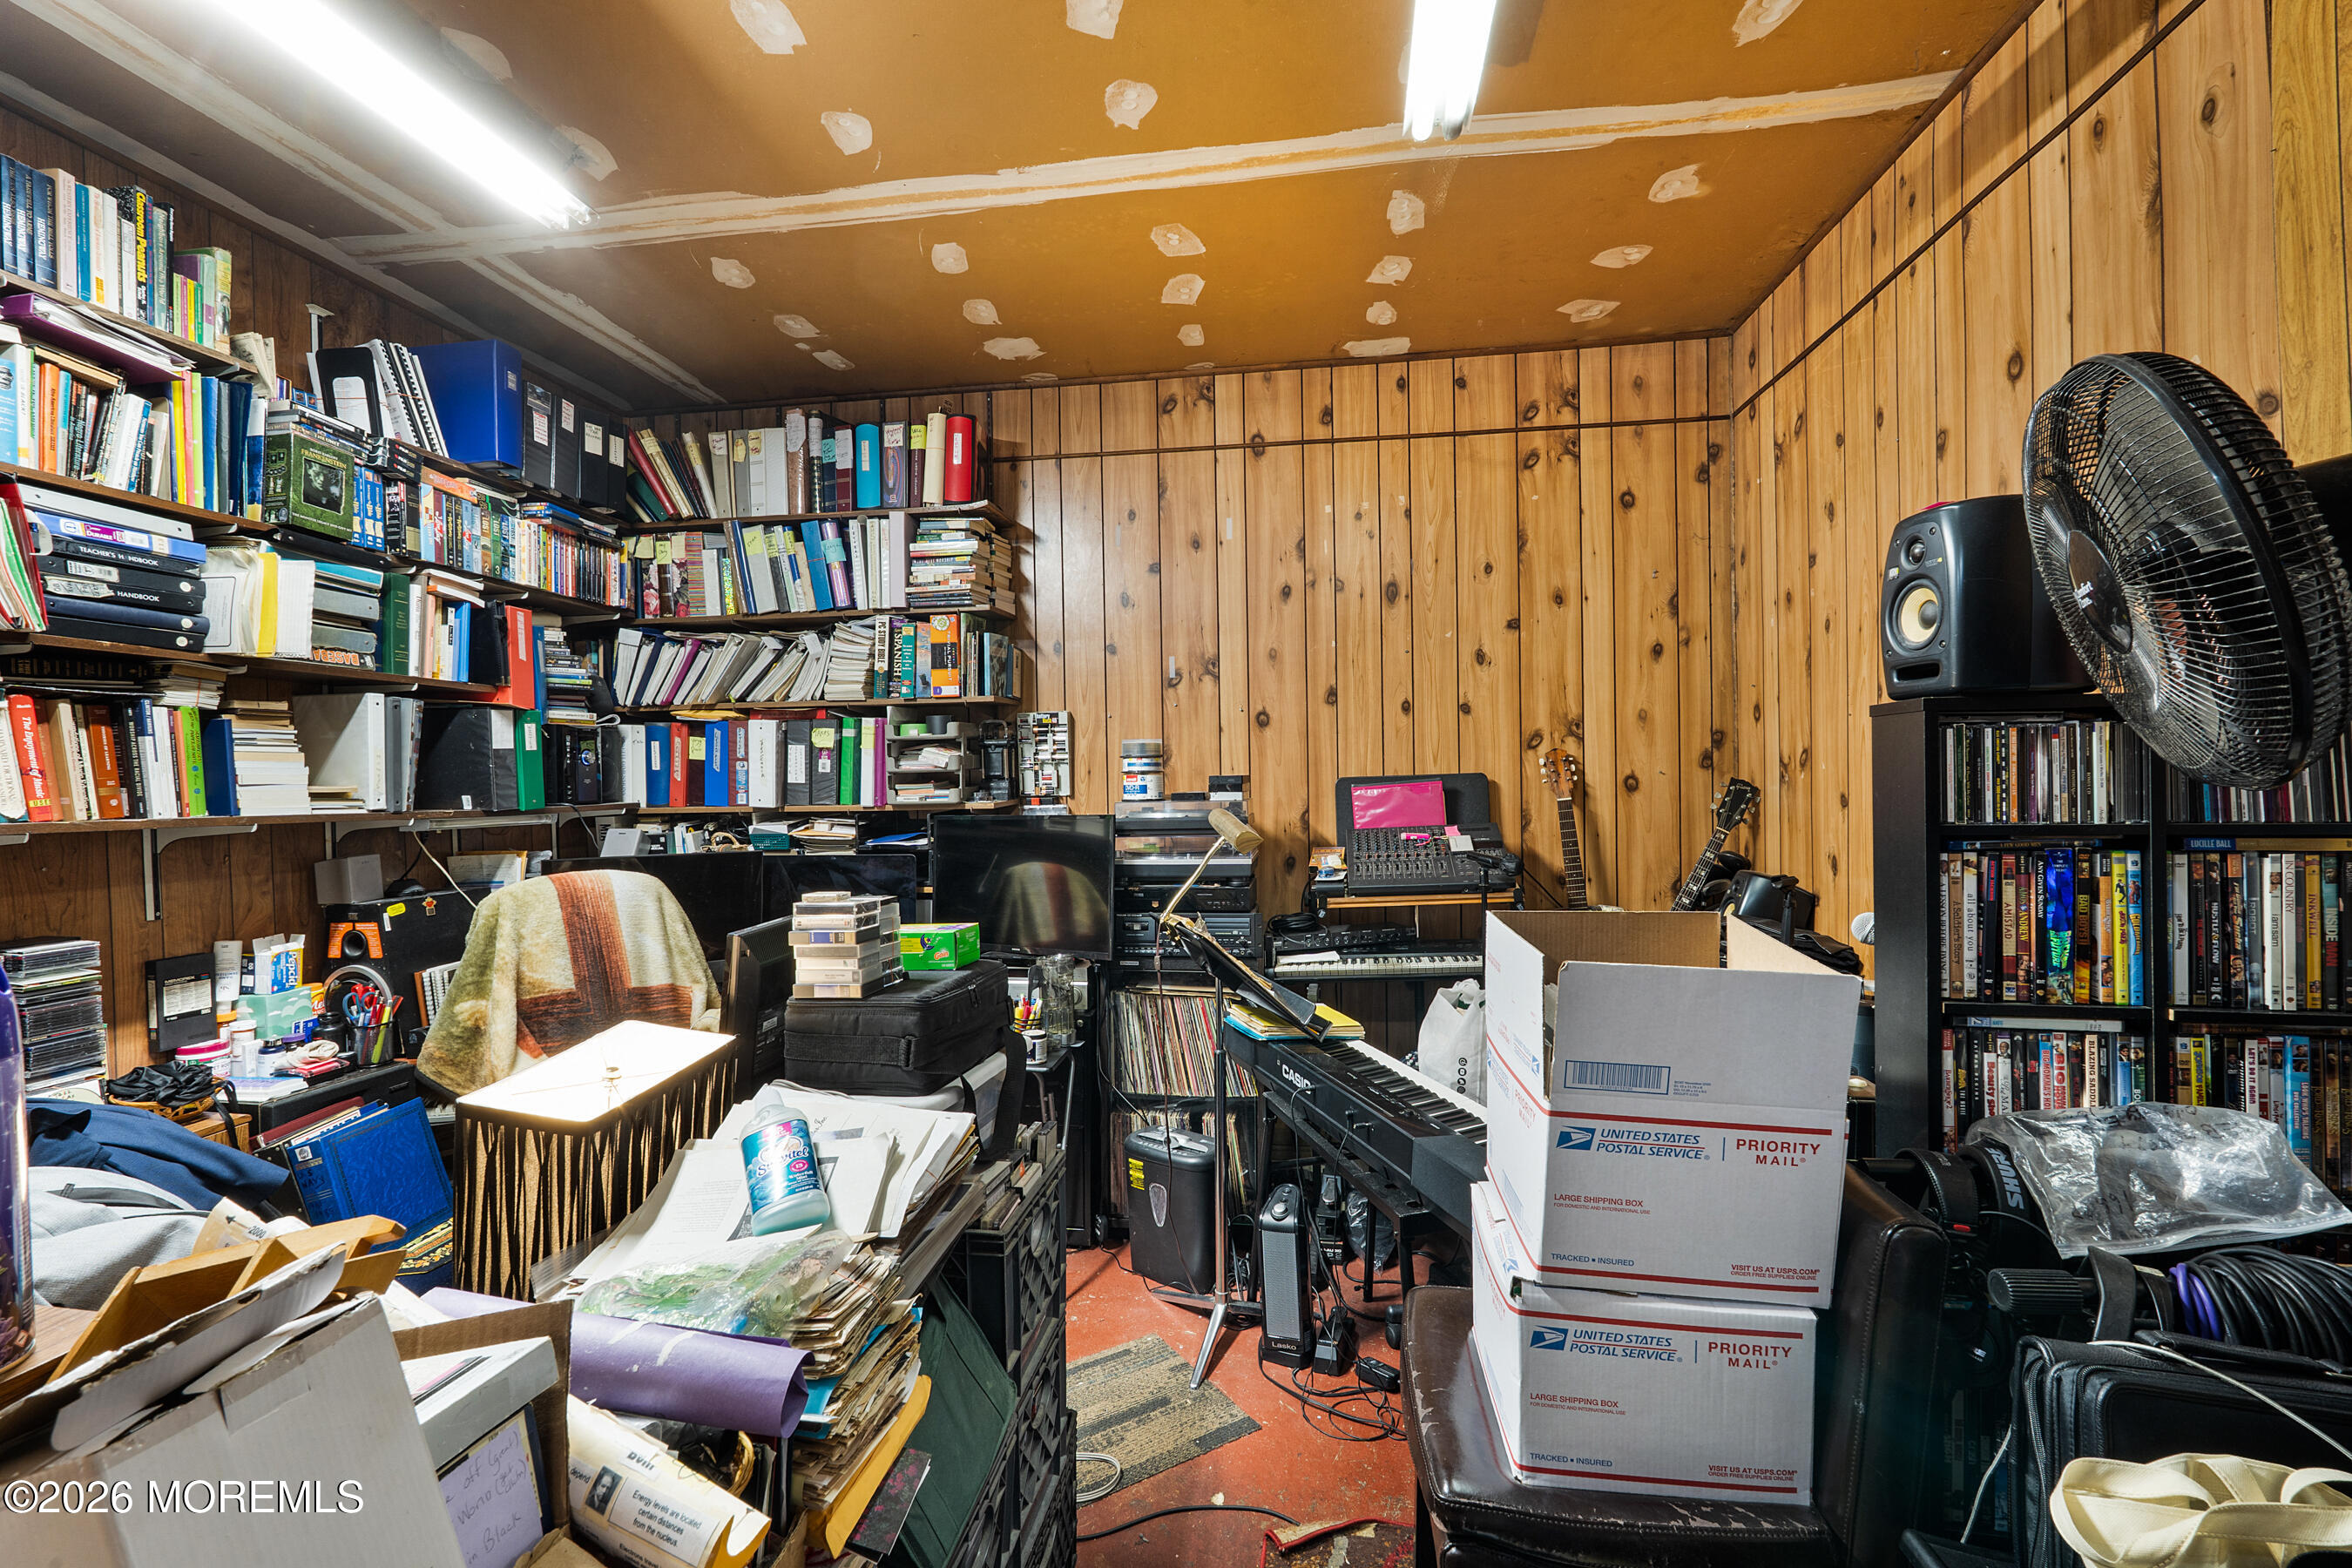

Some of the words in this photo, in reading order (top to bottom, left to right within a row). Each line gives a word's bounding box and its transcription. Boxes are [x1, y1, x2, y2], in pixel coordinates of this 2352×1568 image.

[3, 202, 13, 247] HEMINGWAY
[137, 192, 145, 237] Classroom
[17, 208, 28, 253] HEMINGWAY
[37, 217, 47, 260] HEMINGWAY
[137, 236, 147, 283] Peanuts
[77, 419, 85, 439] Negro
[73, 439, 83, 470] Literature
[301, 448, 347, 470] FRANKENSTEIN
[85, 530, 113, 541] DURABLE
[79, 546, 116, 558] TEACHER'S
[484, 563, 490, 572] 2
[495, 565, 500, 575] 3
[117, 591, 160, 603] HANDBOOK
[878, 621, 886, 630] PC
[894, 633, 902, 676] SPANISH
[22, 716, 31, 732] The
[24, 732, 39, 770] Enjoyment
[32, 776, 44, 799] Music
[2216, 840, 2232, 848] BALL
[2285, 860, 2294, 870] IN
[1967, 894, 1976, 906] all
[2285, 871, 2295, 914] COUNTRY
[2078, 896, 2088, 913] BAD
[1953, 907, 1962, 943] Soldier's
[2004, 902, 2013, 940] AMISTAD
[2078, 914, 2088, 936] BOYS
[2308, 894, 2317, 936] INKWELL
[2326, 908, 2338, 942] INSIDE
[2019, 912, 2029, 942] ANDREW
[2232, 916, 2243, 950] Sucka
[1965, 936, 1975, 951] you
[934, 951, 949, 960] Gain
[1952, 943, 1963, 965] Story
[2326, 942, 2338, 967] MAN
[285, 951, 298, 986] Pepcid
[165, 975, 196, 983] MEMOREX
[2042, 1050, 2051, 1062] BIG
[2054, 1053, 2065, 1085] BIG
[1282, 1064, 1311, 1095] CASIO
[1986, 1061, 1996, 1098] Beauty
[2042, 1063, 2051, 1096] MOMMA'S
[1600, 1128, 1652, 1142] UNITED
[1652, 1132, 1700, 1145] STATES
[1597, 1142, 1646, 1156] POSTAL
[1736, 1139, 1821, 1155] PRIORITY
[1985, 1147, 2025, 1210] SHURE
[1554, 1193, 1582, 1202] LARGE
[1583, 1196, 1624, 1206] SHIPPING
[1625, 1199, 1644, 1207] BOX
[247, 1225, 267, 1239] 2000
[1551, 1253, 1590, 1263] TRACKED
[1598, 1257, 1634, 1267] INSURED
[1272, 1342, 1297, 1350] Lasko
[1573, 1328, 1624, 1342] UNITED
[1625, 1334, 1673, 1347] STATES
[1570, 1342, 1619, 1357] POSTAL
[1708, 1342, 1792, 1357] PRIORITY
[1530, 1393, 1558, 1402] LARGE
[1559, 1396, 1599, 1407] SHIPPING
[1600, 1399, 1619, 1408] BOX
[1578, 1406, 1616, 1415] INTERNATIONAL
[1530, 1453, 1569, 1463] TRACKED
[1576, 1457, 1612, 1467] INSURED
[570, 1466, 591, 1484] depend
[632, 1489, 653, 1507] Energy
[652, 1499, 670, 1515] levels
[670, 1509, 680, 1519] are
[679, 1512, 703, 1530] located
[638, 1507, 658, 1523] certain
[657, 1516, 684, 1536] distances
[467, 1552, 478, 1565] in
[483, 1511, 522, 1553] Black
[632, 1518, 647, 1531] from
[646, 1524, 656, 1535] the
[656, 1530, 679, 1548] nucleus.
[619, 1543, 644, 1563] Electrons
